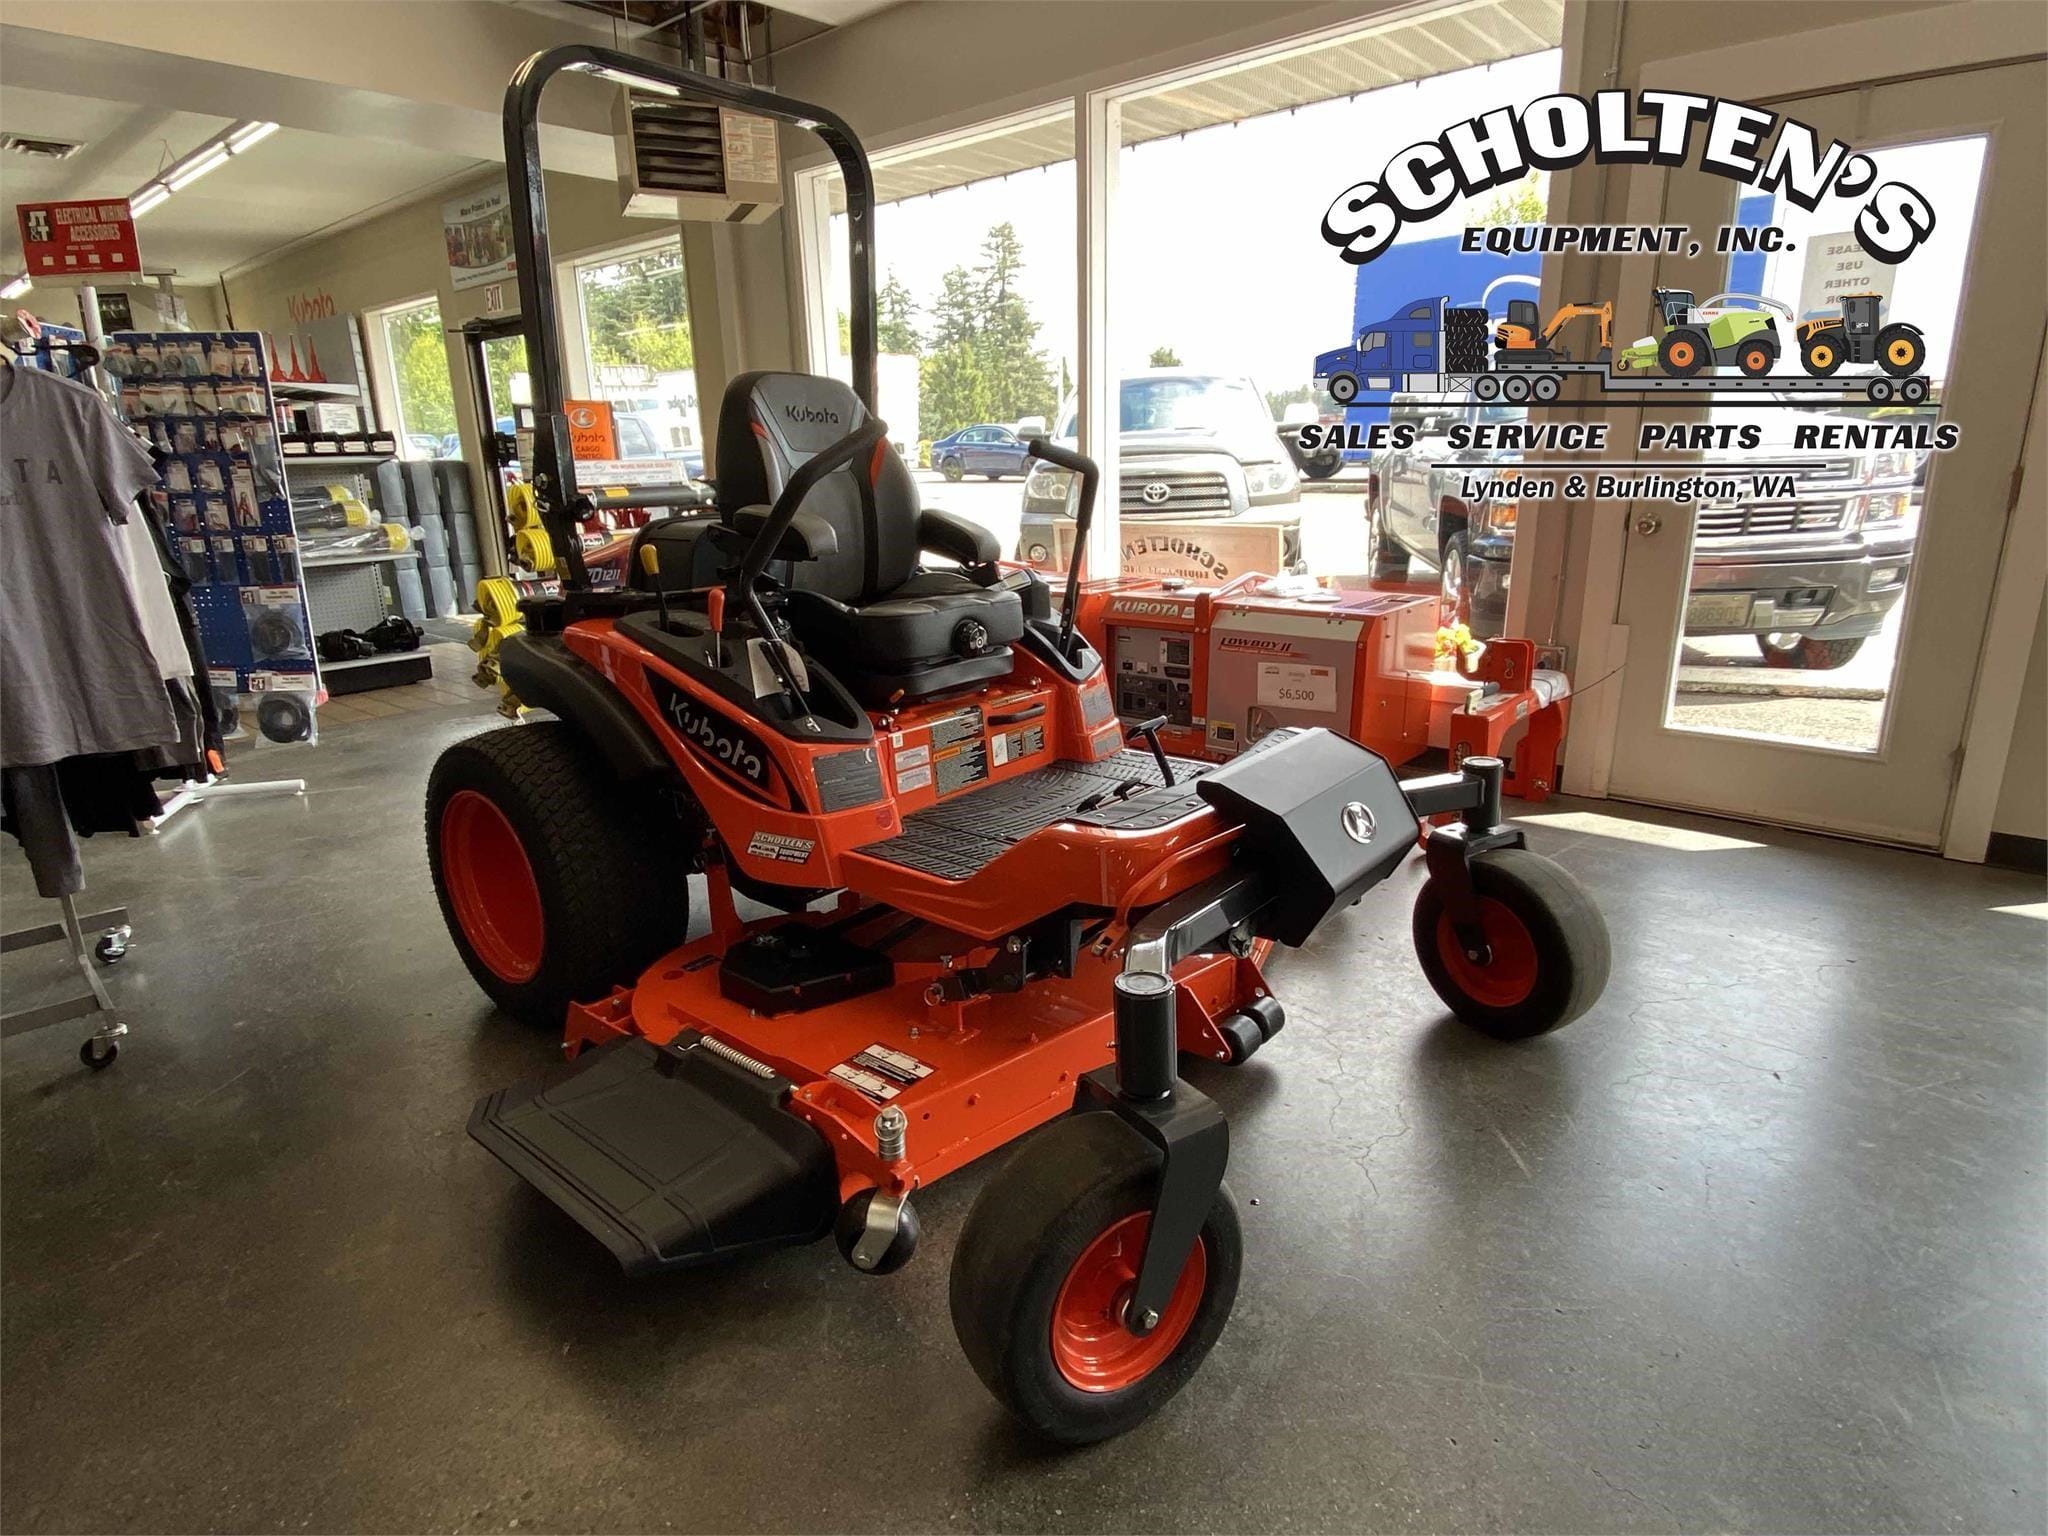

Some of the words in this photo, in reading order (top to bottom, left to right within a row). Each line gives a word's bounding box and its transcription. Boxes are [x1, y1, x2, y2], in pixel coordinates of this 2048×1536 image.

[55, 206, 98, 225] ELECTRICAL
[70, 223, 120, 242] ACCESSORIES
[485, 286, 502, 312] EXIT
[785, 405, 839, 424] Kubota
[1113, 601, 1179, 616] KUBOTA
[1221, 637, 1279, 650] LOWBOY
[1279, 688, 1315, 701] $6,500
[670, 693, 761, 778] Kubota
